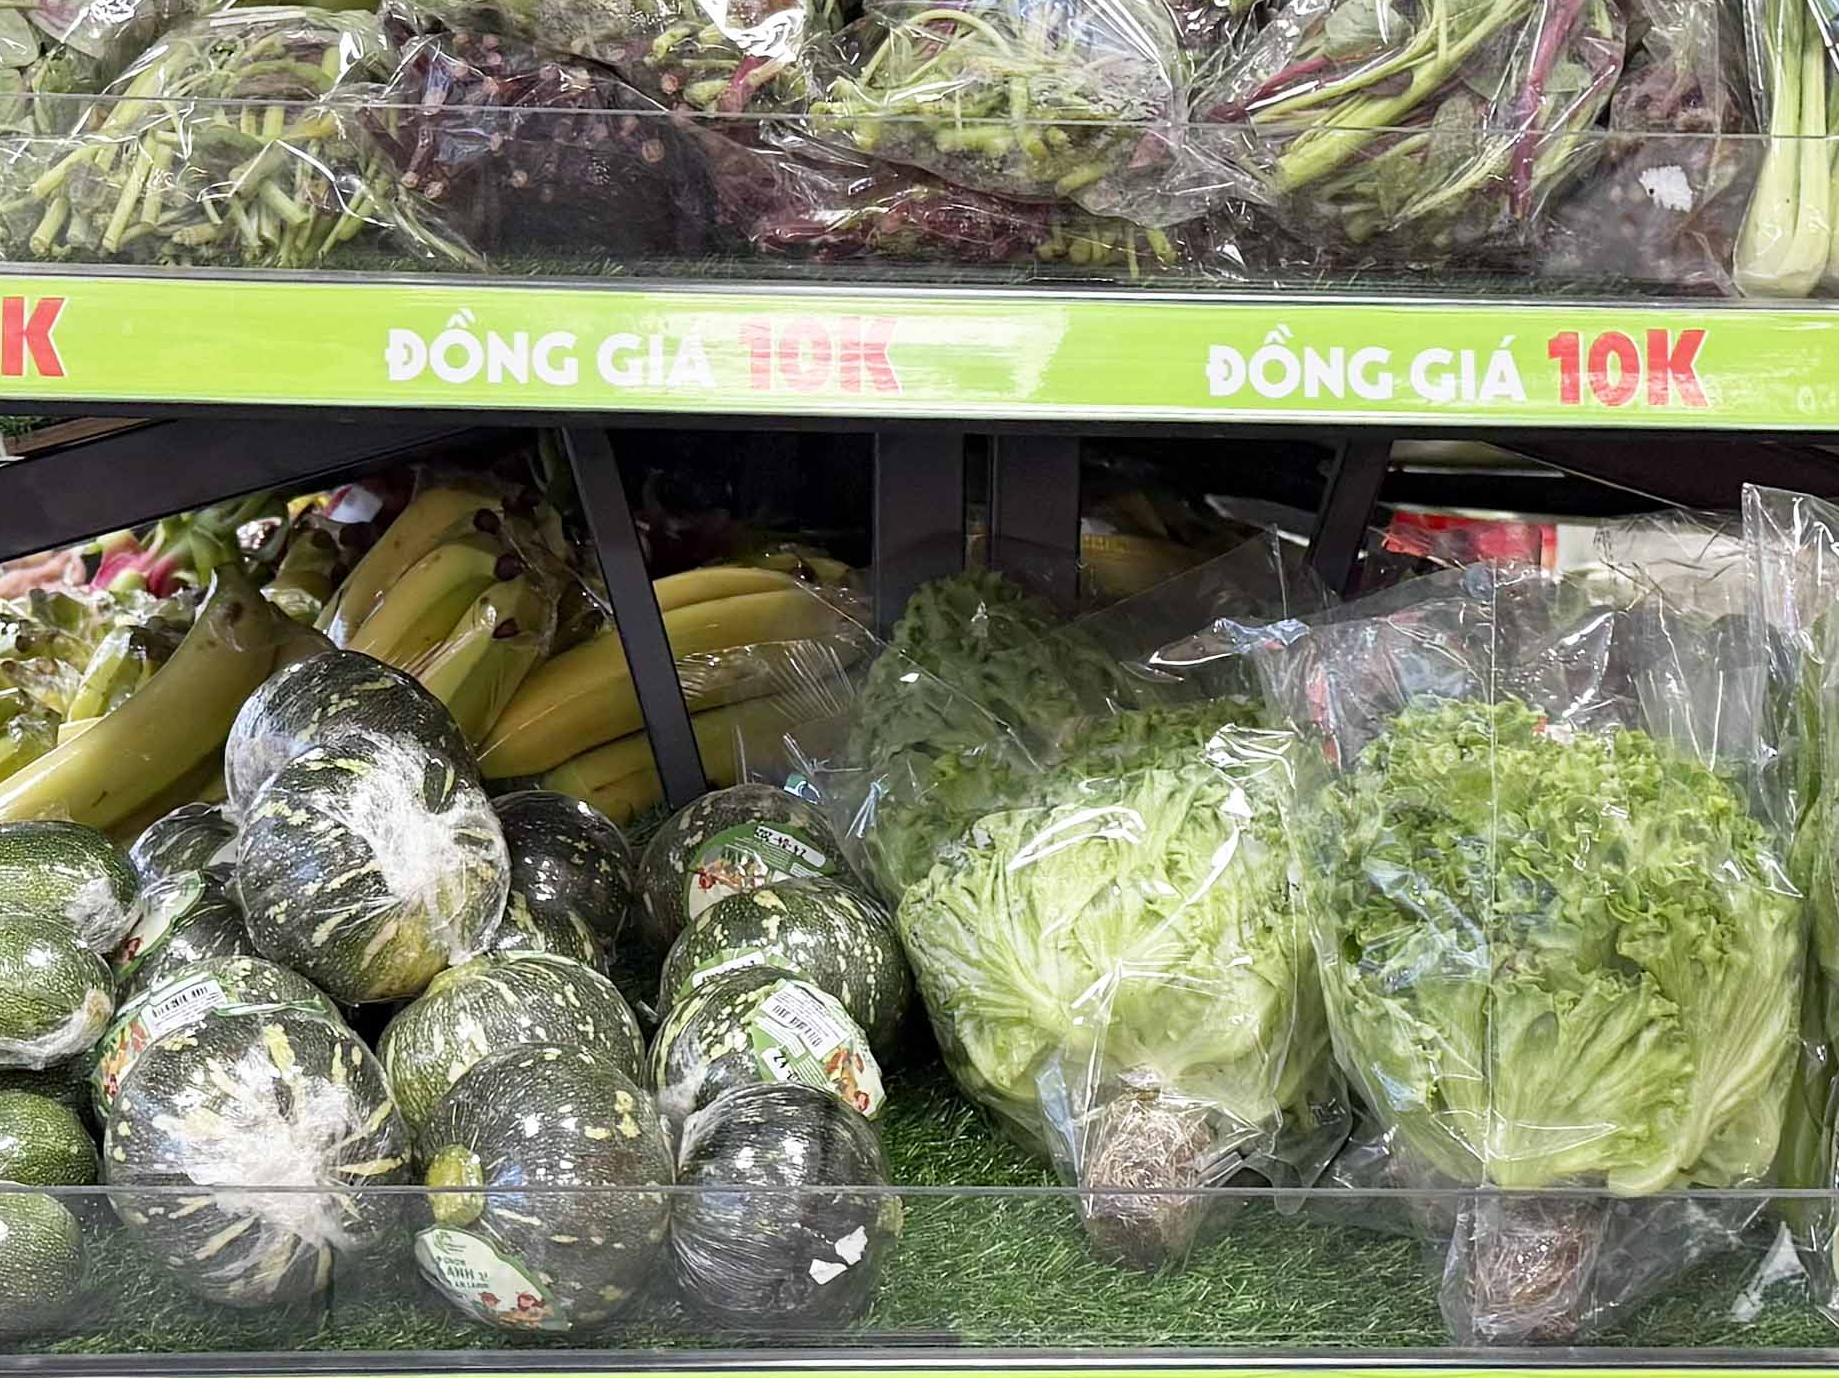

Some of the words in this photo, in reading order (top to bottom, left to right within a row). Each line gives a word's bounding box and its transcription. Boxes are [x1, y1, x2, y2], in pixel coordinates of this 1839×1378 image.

[385, 307, 579, 386] ĐỒNG
[598, 313, 718, 390] GIÁ
[739, 315, 898, 394] 10K
[1205, 324, 1395, 400] ĐỒNG
[1409, 331, 1526, 406] GIÁ
[1547, 329, 1708, 408] 10K
